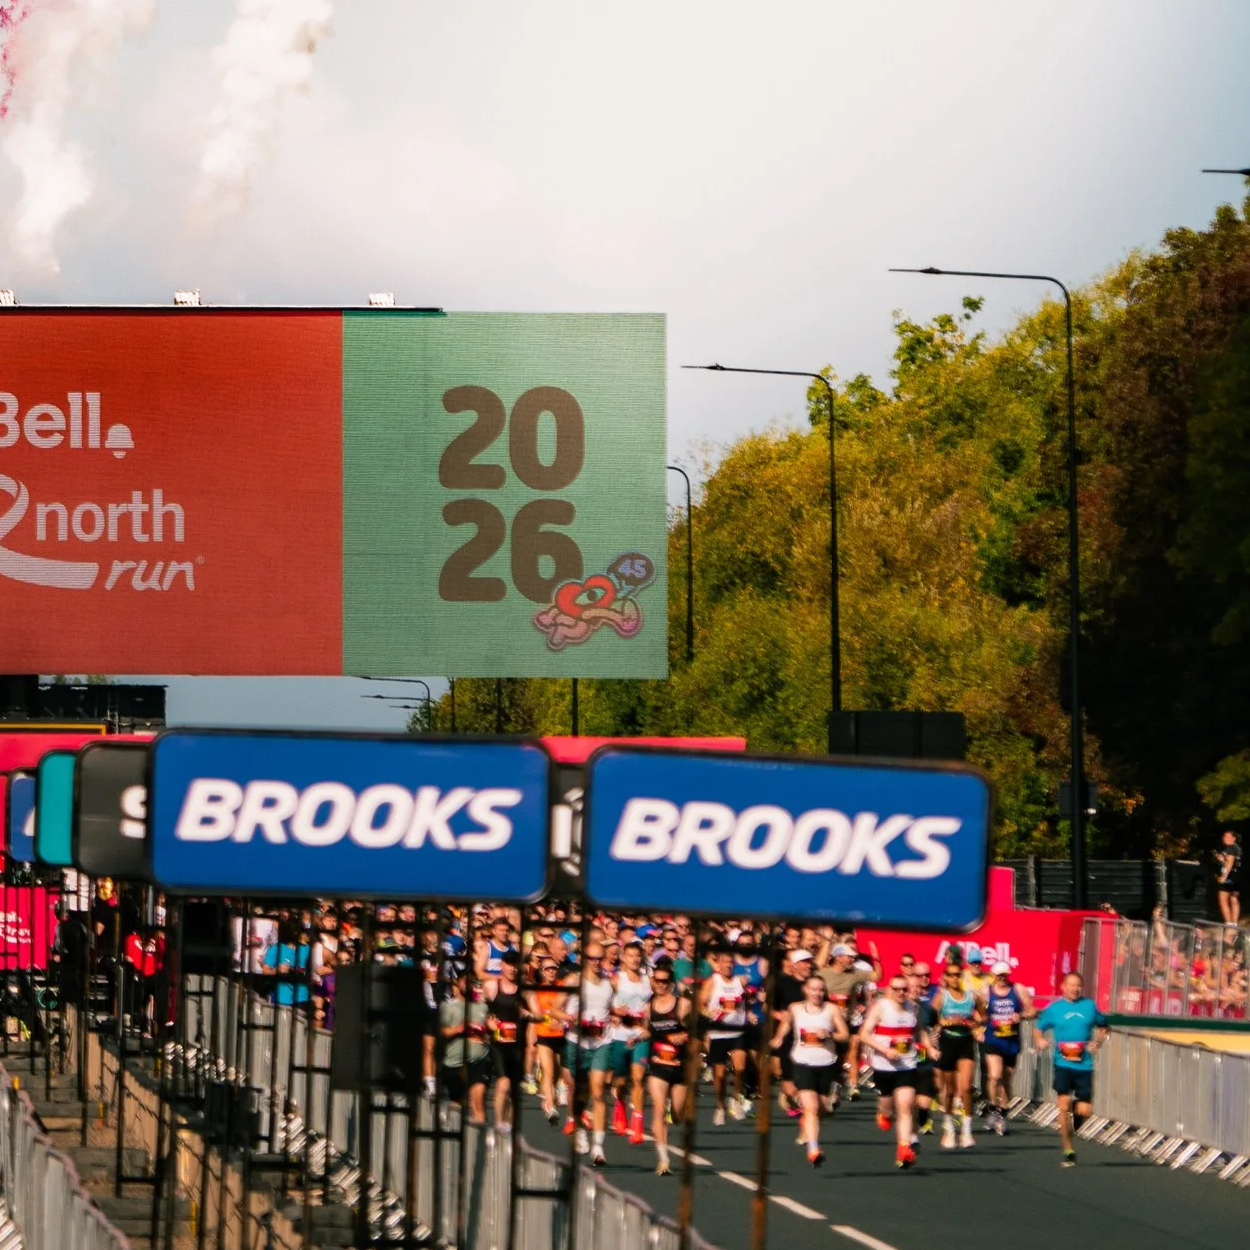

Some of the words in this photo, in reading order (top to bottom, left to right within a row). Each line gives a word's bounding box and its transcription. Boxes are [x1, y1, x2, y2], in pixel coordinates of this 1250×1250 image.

[439, 384, 586, 492] 20
[36, 489, 186, 542] north
[439, 498, 584, 604] 26
[104, 559, 196, 591] run
[618, 558, 647, 578] 45
[174, 777, 522, 851] BROOKS
[609, 796, 962, 879] BROOKS
